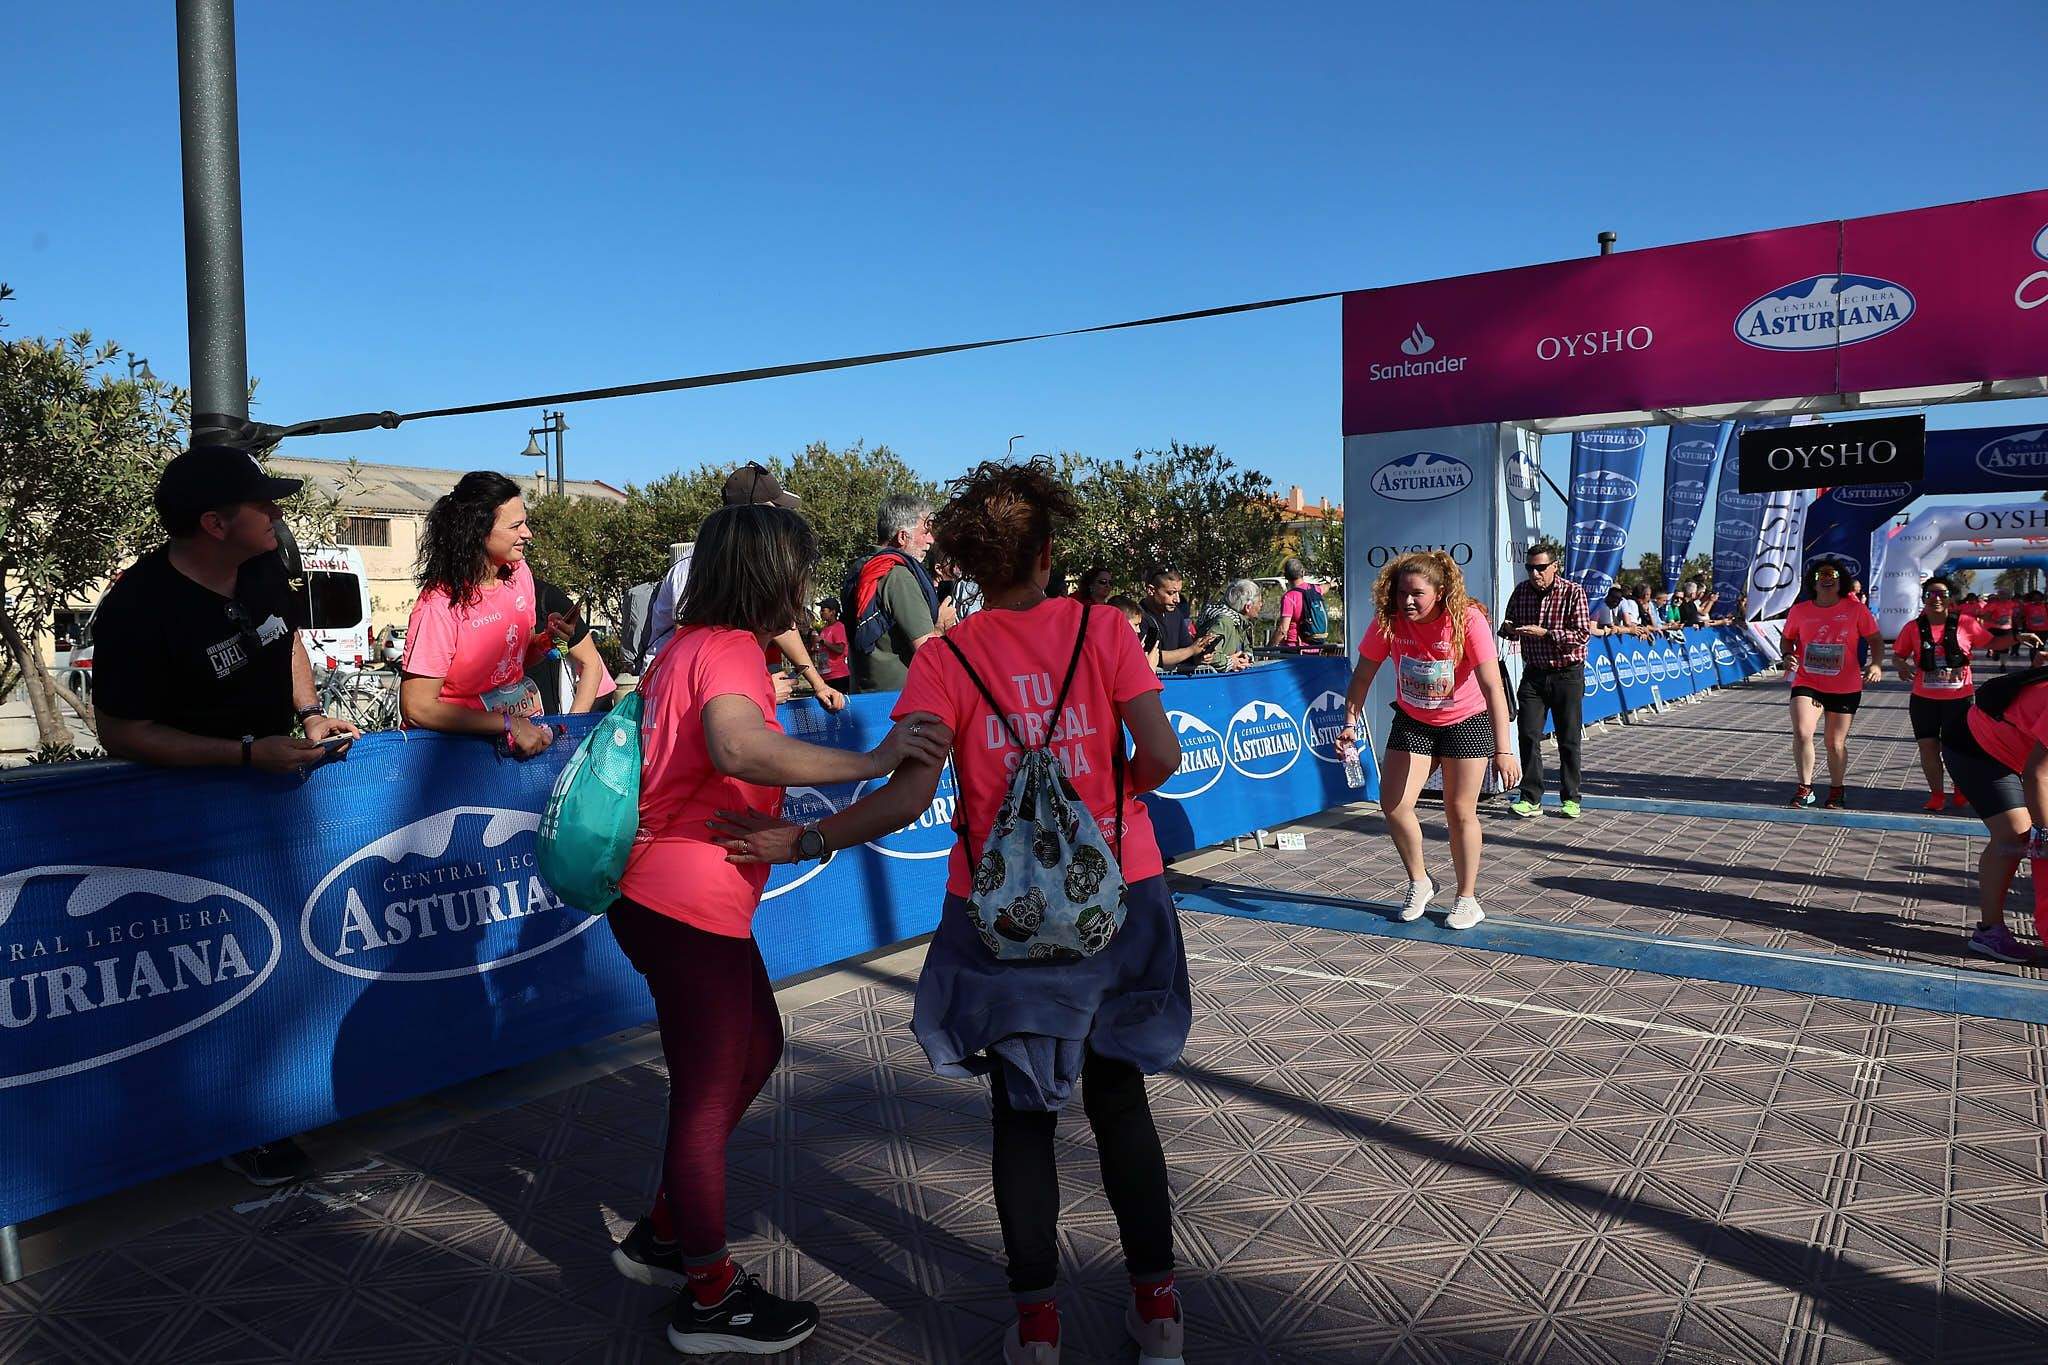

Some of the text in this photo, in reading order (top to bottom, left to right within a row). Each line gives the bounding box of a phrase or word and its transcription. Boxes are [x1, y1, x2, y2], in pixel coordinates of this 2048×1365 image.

[1773, 290, 1895, 313] CENTRAL ECHERA
[1747, 302, 1900, 338] ASTURIANA
[1536, 325, 1653, 360] OYSHO
[1369, 355, 1467, 381] Santander
[1579, 433, 1640, 445] ASTURIANA
[1675, 450, 1711, 461] ASTURIA
[1767, 440, 1897, 471] OYSHO
[1378, 473, 1465, 492] ASTURIANA
[1575, 484, 1632, 497] ASTURIANA
[1836, 484, 1906, 499] ASTURIANA
[1965, 509, 2048, 531] OYSH
[1506, 541, 1530, 564] OYSH
[303, 559, 350, 572] LANCIA
[471, 612, 503, 629] OYSHO
[1011, 672, 1055, 709] TU
[985, 703, 1097, 750] DORSAL
[1241, 721, 1292, 737] CENTRAL LECHERA
[1185, 734, 1215, 748] LECHERA
[1234, 731, 1298, 763] ASTURIANA
[1004, 743, 1092, 786] SMA
[1175, 746, 1222, 775] RIANA
[782, 800, 818, 817] HERA
[383, 861, 488, 894] CENTRAL
[86, 907, 233, 948] LECHERA
[335, 875, 563, 957] ASTURIA
[0, 933, 255, 1029] URIANA
